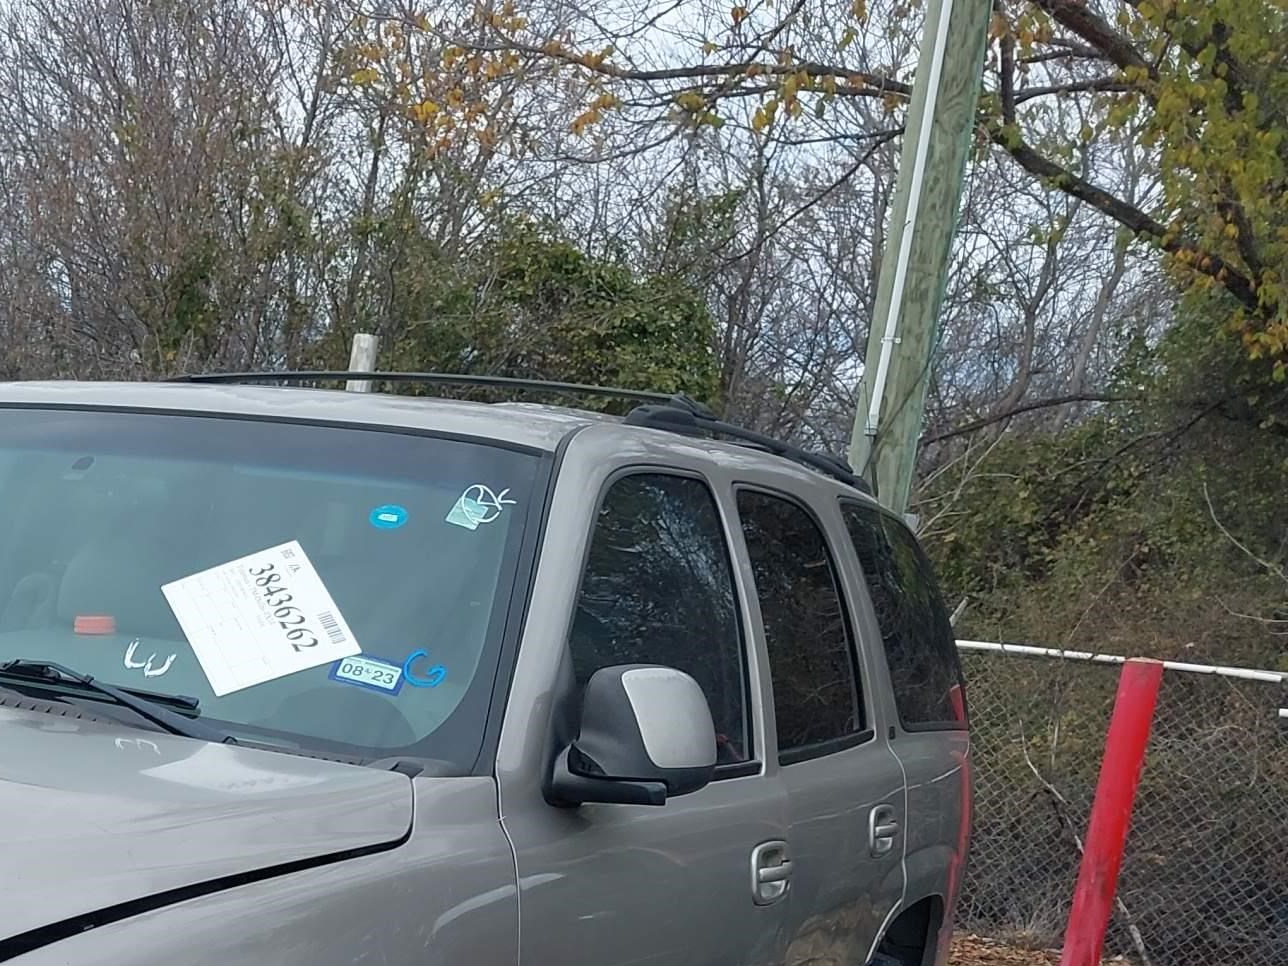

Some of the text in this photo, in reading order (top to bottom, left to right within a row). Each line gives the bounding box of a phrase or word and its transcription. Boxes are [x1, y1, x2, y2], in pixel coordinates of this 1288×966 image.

[248, 562, 319, 653] 38436262
[341, 662, 395, 685] 08 23
